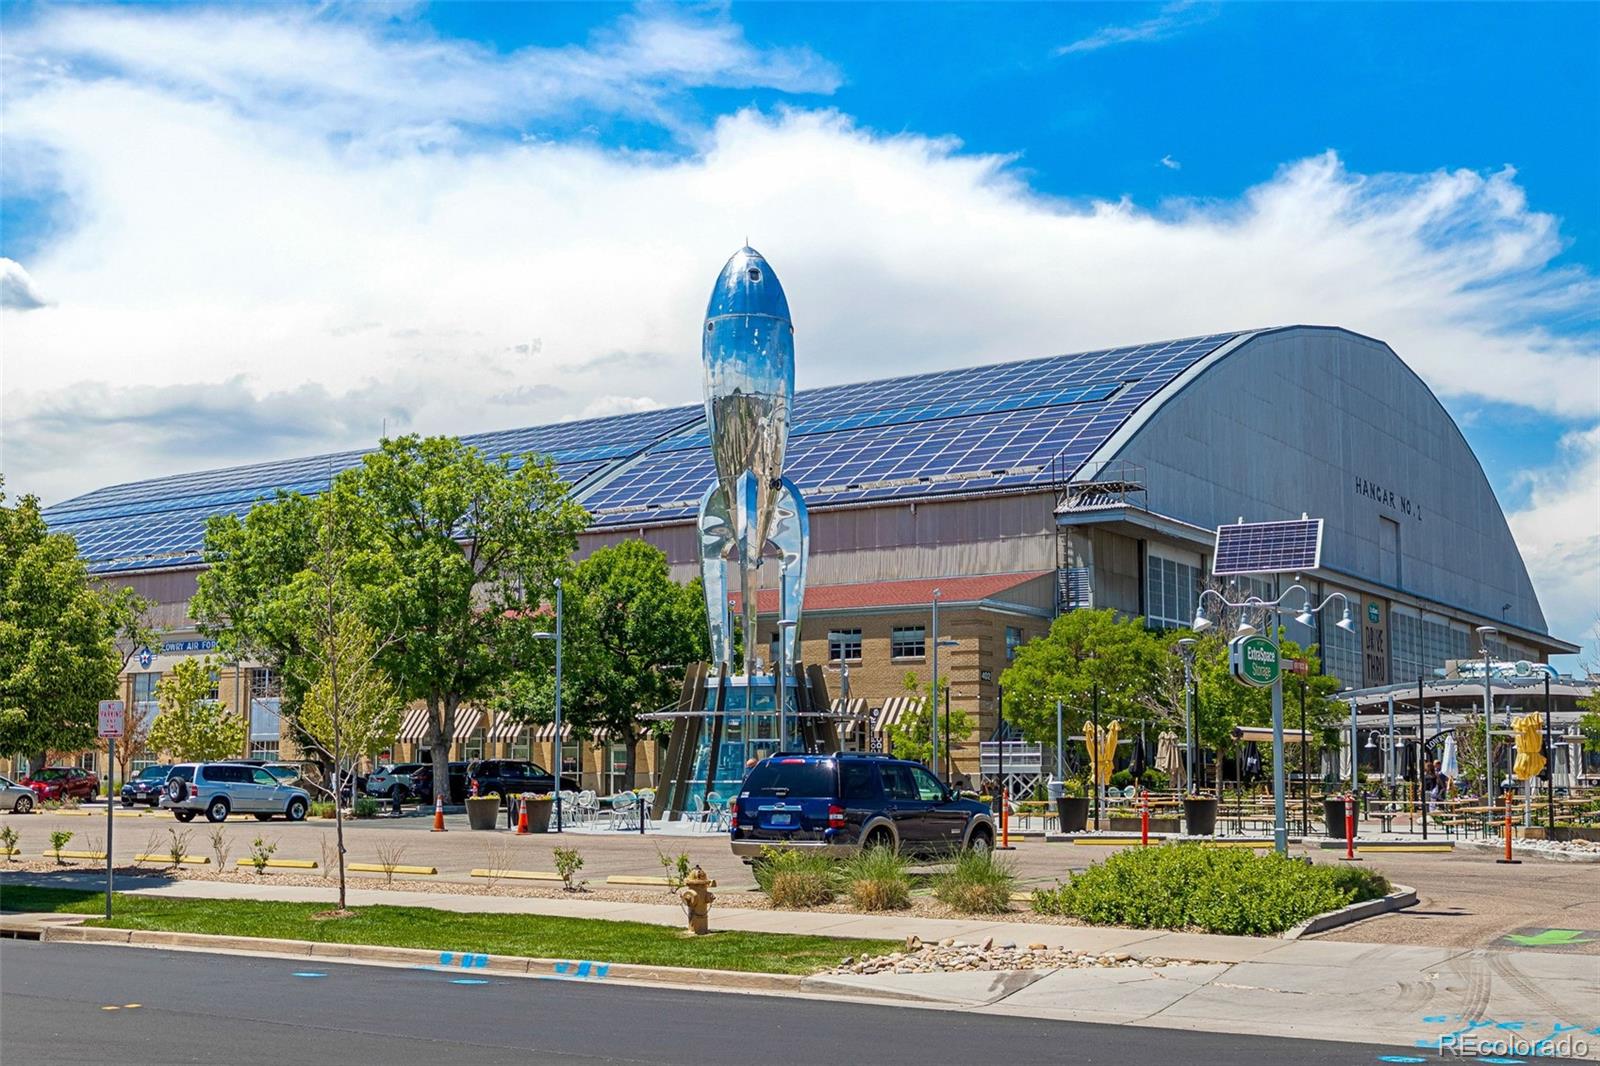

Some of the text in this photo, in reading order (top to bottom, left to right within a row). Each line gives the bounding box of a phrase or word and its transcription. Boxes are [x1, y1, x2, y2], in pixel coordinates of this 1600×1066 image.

[186, 641, 199, 650] AIR
[1252, 661, 1271, 679] Storage
[1367, 653, 1385, 681] THRU
